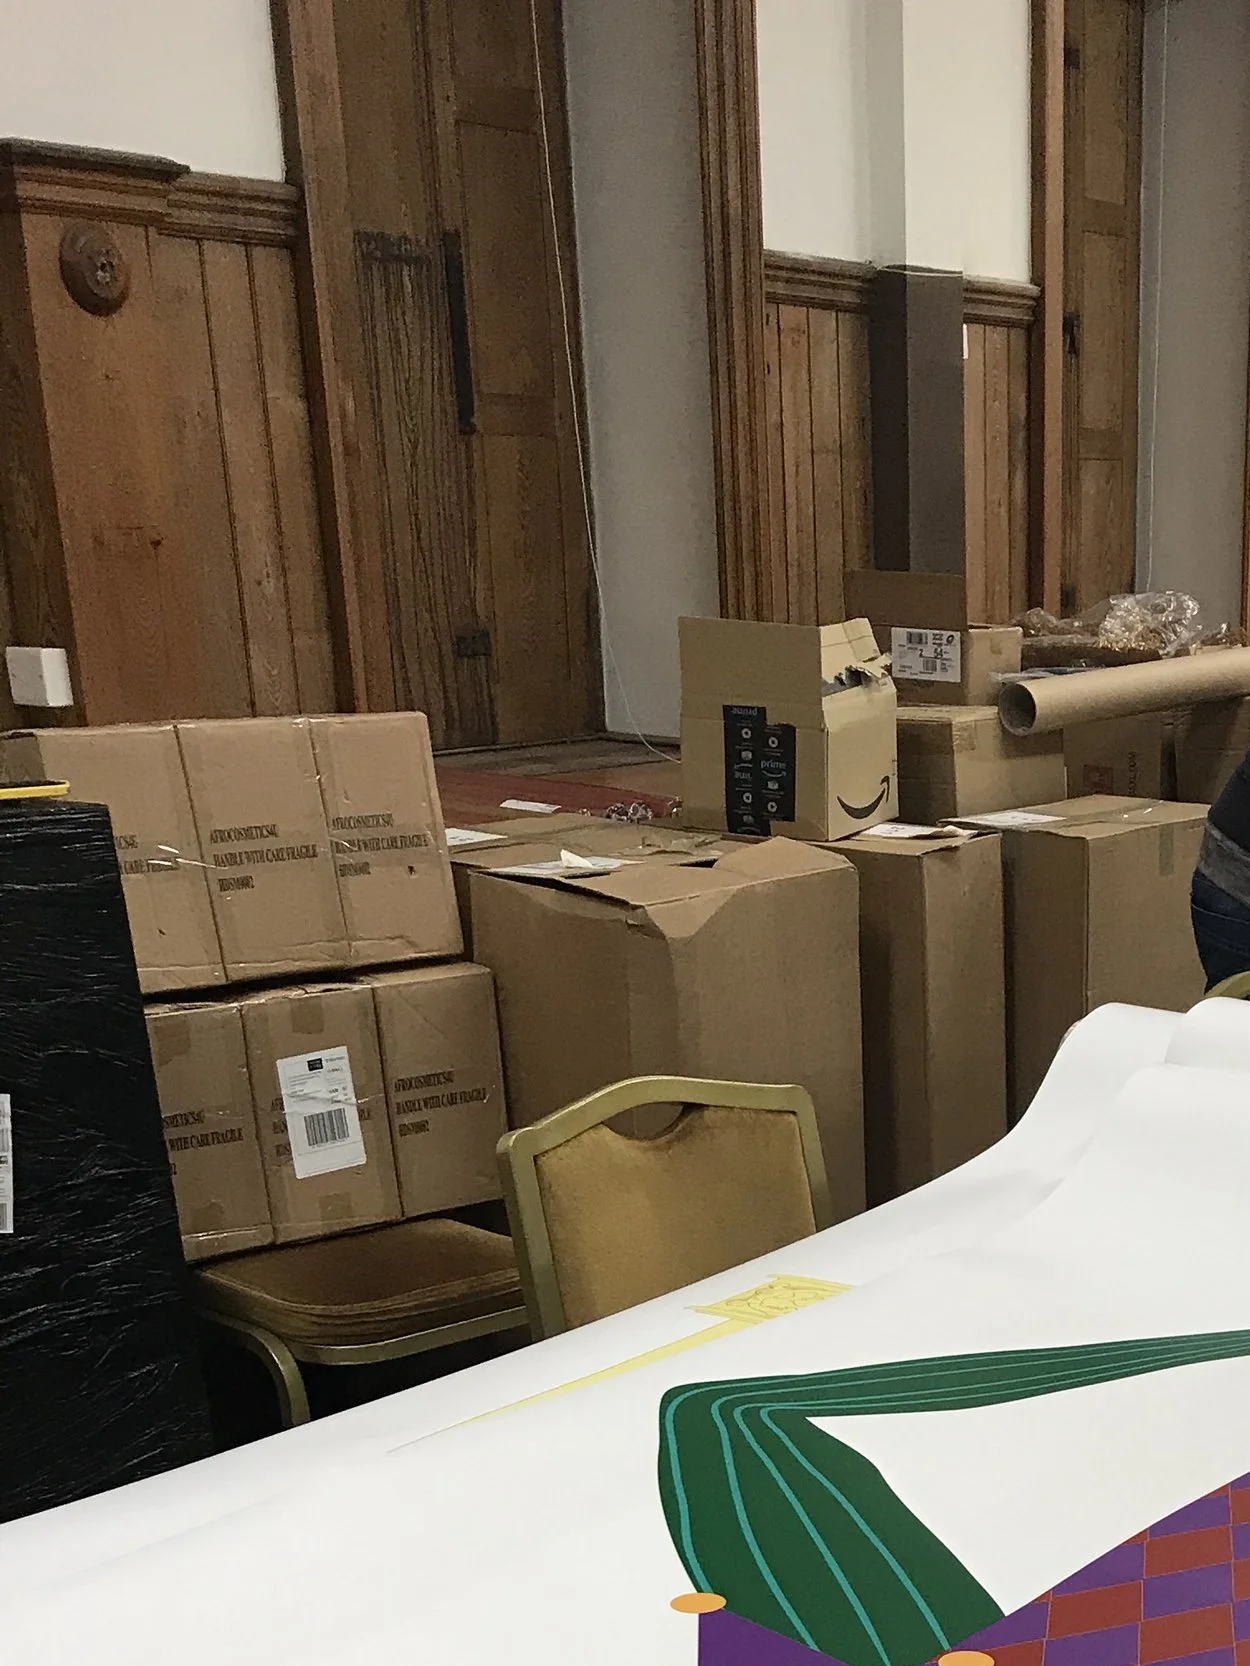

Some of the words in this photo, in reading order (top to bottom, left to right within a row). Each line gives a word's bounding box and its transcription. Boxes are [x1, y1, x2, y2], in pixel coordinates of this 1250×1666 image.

[760, 759, 787, 770] prime
[213, 852, 245, 867] HANDLE
[244, 850, 265, 865] WITH
[265, 847, 286, 863] CARE
[286, 844, 319, 861] FRAGILE
[395, 1099, 422, 1115] HANDLE
[422, 1095, 441, 1110] WITH
[441, 1092, 459, 1107] CARE
[459, 1088, 487, 1104] FRAGILE
[190, 1134, 211, 1149] CARE
[211, 1127, 244, 1146] FRAGILE
